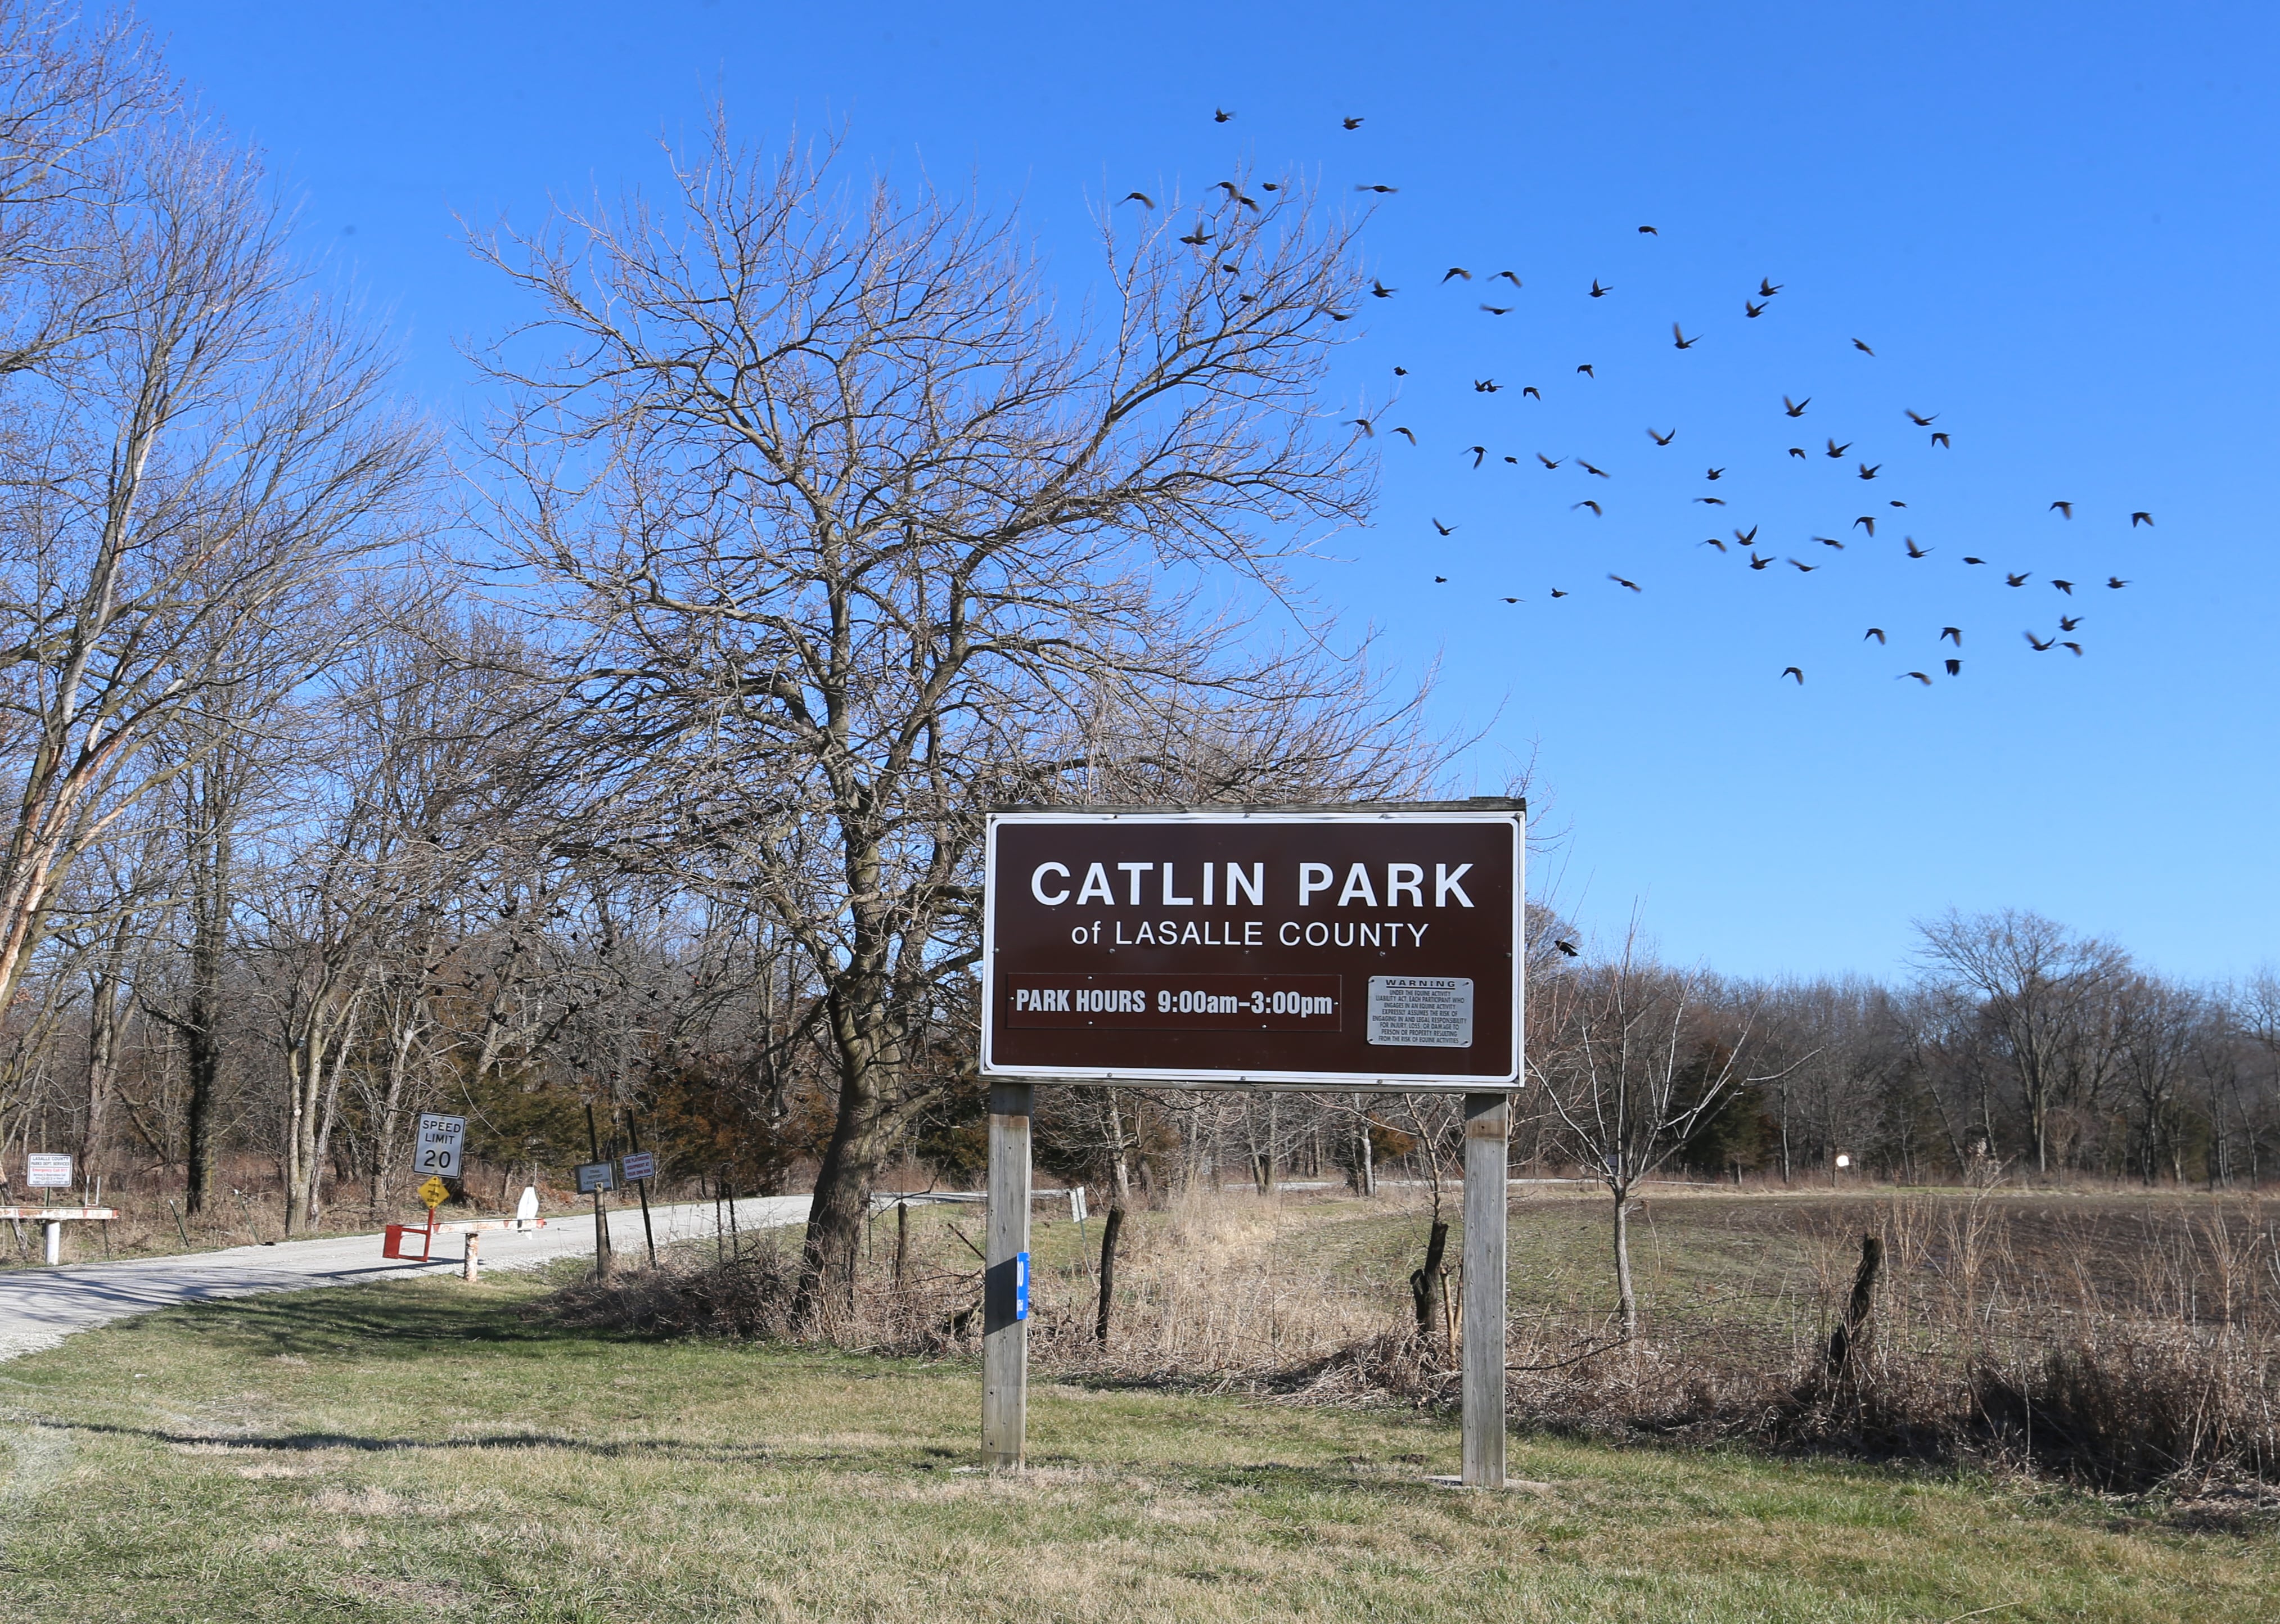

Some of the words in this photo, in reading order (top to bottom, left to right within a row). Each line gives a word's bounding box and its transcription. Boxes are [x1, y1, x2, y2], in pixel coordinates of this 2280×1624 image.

[1031, 862, 1263, 905] CATLIN
[1299, 863, 1474, 907] PARK
[1072, 921, 1101, 944] of
[1116, 921, 1262, 945] LASALLE
[1279, 922, 1429, 947] COUNTY
[1017, 990, 1070, 1011] PARK
[1076, 990, 1145, 1012] HOURS
[422, 1120, 461, 1133] SPEED
[425, 1133, 454, 1144] LIMIT
[423, 1150, 451, 1169] 20
